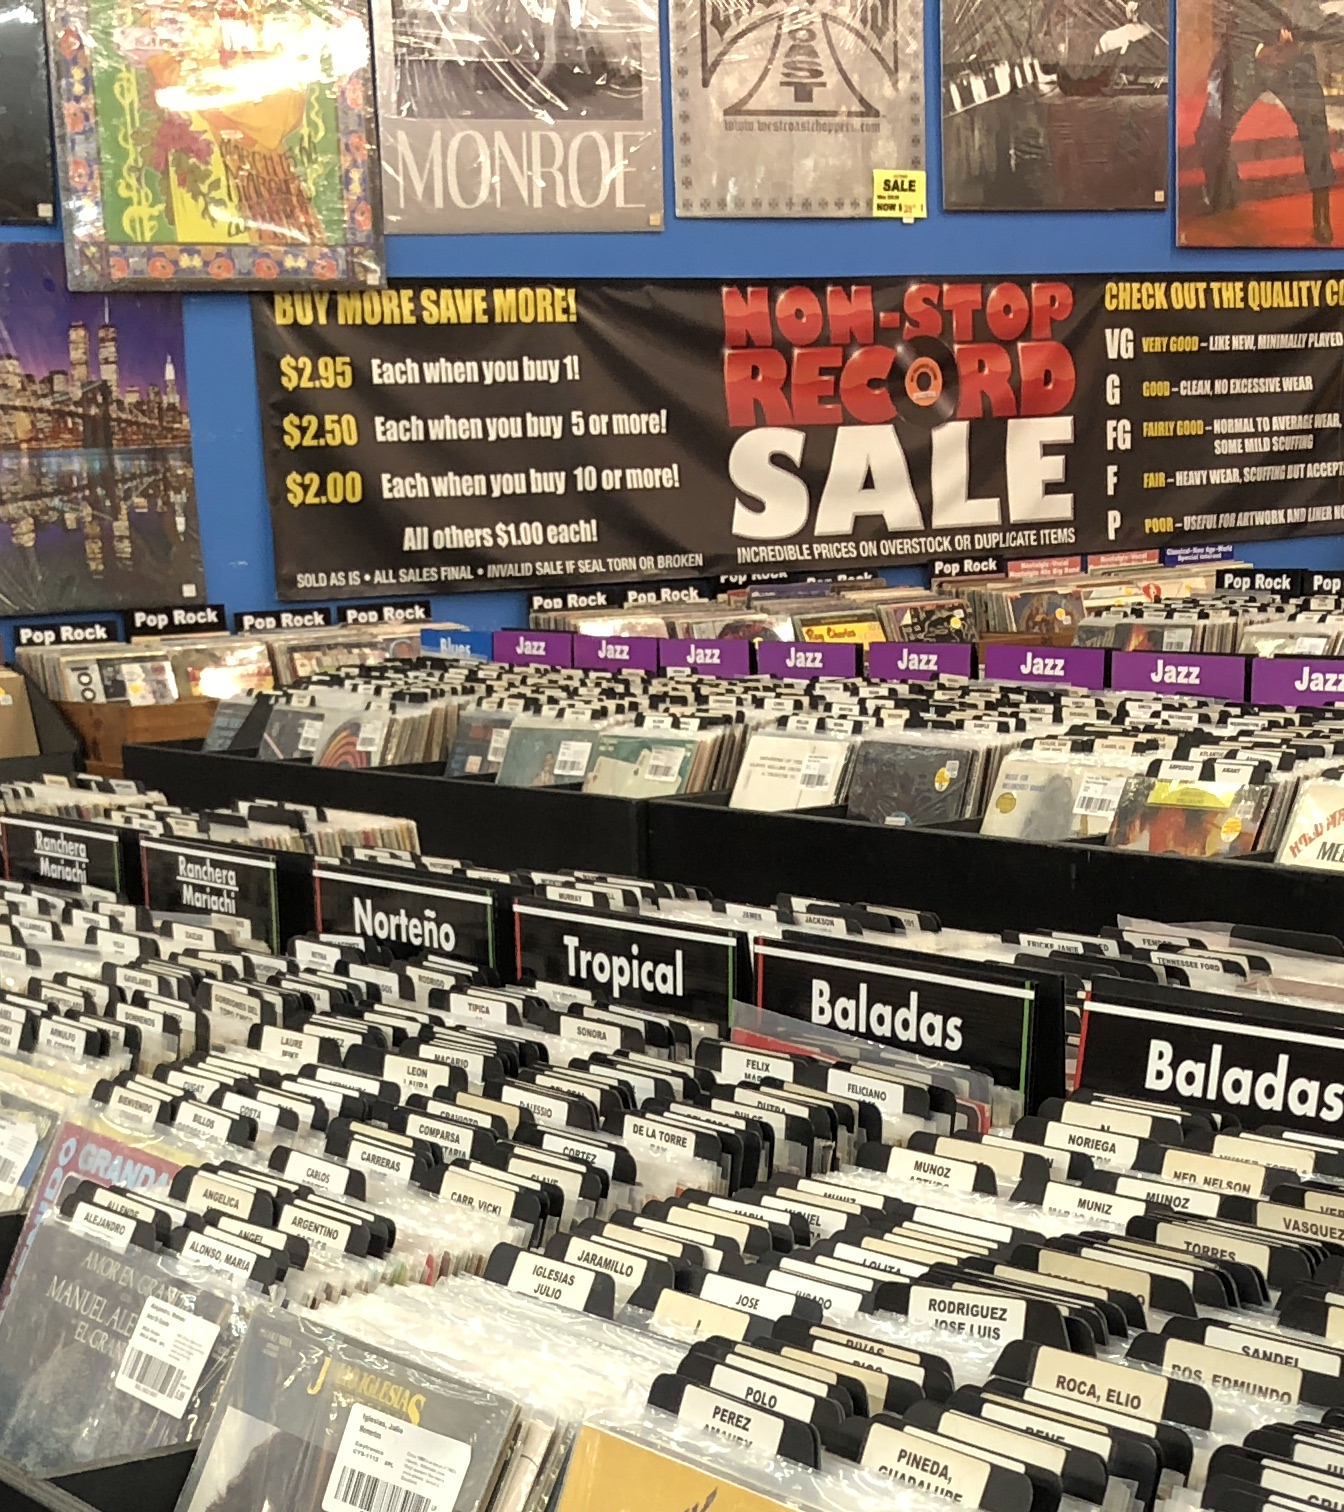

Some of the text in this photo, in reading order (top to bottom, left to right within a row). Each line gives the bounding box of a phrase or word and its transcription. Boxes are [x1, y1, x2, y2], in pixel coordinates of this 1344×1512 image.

[396, 130, 645, 210] MONROE
[882, 179, 916, 193] SALE
[274, 287, 577, 325] BUY MORE SAVE MORE!
[1105, 282, 1168, 310] CHECK
[1171, 282, 1208, 310] OUT
[1210, 281, 1245, 309] THE
[1248, 280, 1322, 311] QUALITY
[722, 282, 1073, 346] NON-STOP
[280, 356, 580, 390] $2.95 Each when you buy 1!
[724, 337, 1076, 428] RECORD
[283, 409, 667, 448] $2.50 Each when you buy 5 or more!
[287, 464, 680, 506] $2.00 Each when you buy 10 or more!
[729, 416, 1074, 540] SALE
[403, 520, 598, 552] All others $1.00 each!
[737, 528, 1075, 564] INCREDIBLE PRICES ON OVERSTOCK OR DUPLICATE ITEMS
[297, 553, 703, 588] SOLD AS IS ALL SALES FINAL INVALID SALE IF SEAL TORN OR BROKEN
[20, 624, 107, 645] Pop Rock
[1150, 660, 1201, 685] Jazz
[177, 855, 238, 889] Ranchera
[182, 883, 237, 914] Mariachi
[354, 897, 456, 953] Norteño
[563, 935, 684, 1000] Tropical
[811, 979, 963, 1051] Baladas
[847, 1083, 887, 1102] FELICIANO
[1068, 1134, 1116, 1154] NORIEGA
[914, 1161, 951, 1178] MUNOZ
[84, 1211, 126, 1236] ALEJANDRO
[532, 1265, 576, 1287] IGLESIAS
[577, 1251, 633, 1277] JARAMILLO
[533, 1283, 562, 1301] JULIO
[928, 1299, 1007, 1323] RODRIGUEZ
[971, 1323, 1000, 1341] LUIS
[1056, 1376, 1142, 1410] ROCA, ELIO
[712, 1406, 750, 1431] PEREZ
[898, 1448, 952, 1483] PINEDA,
